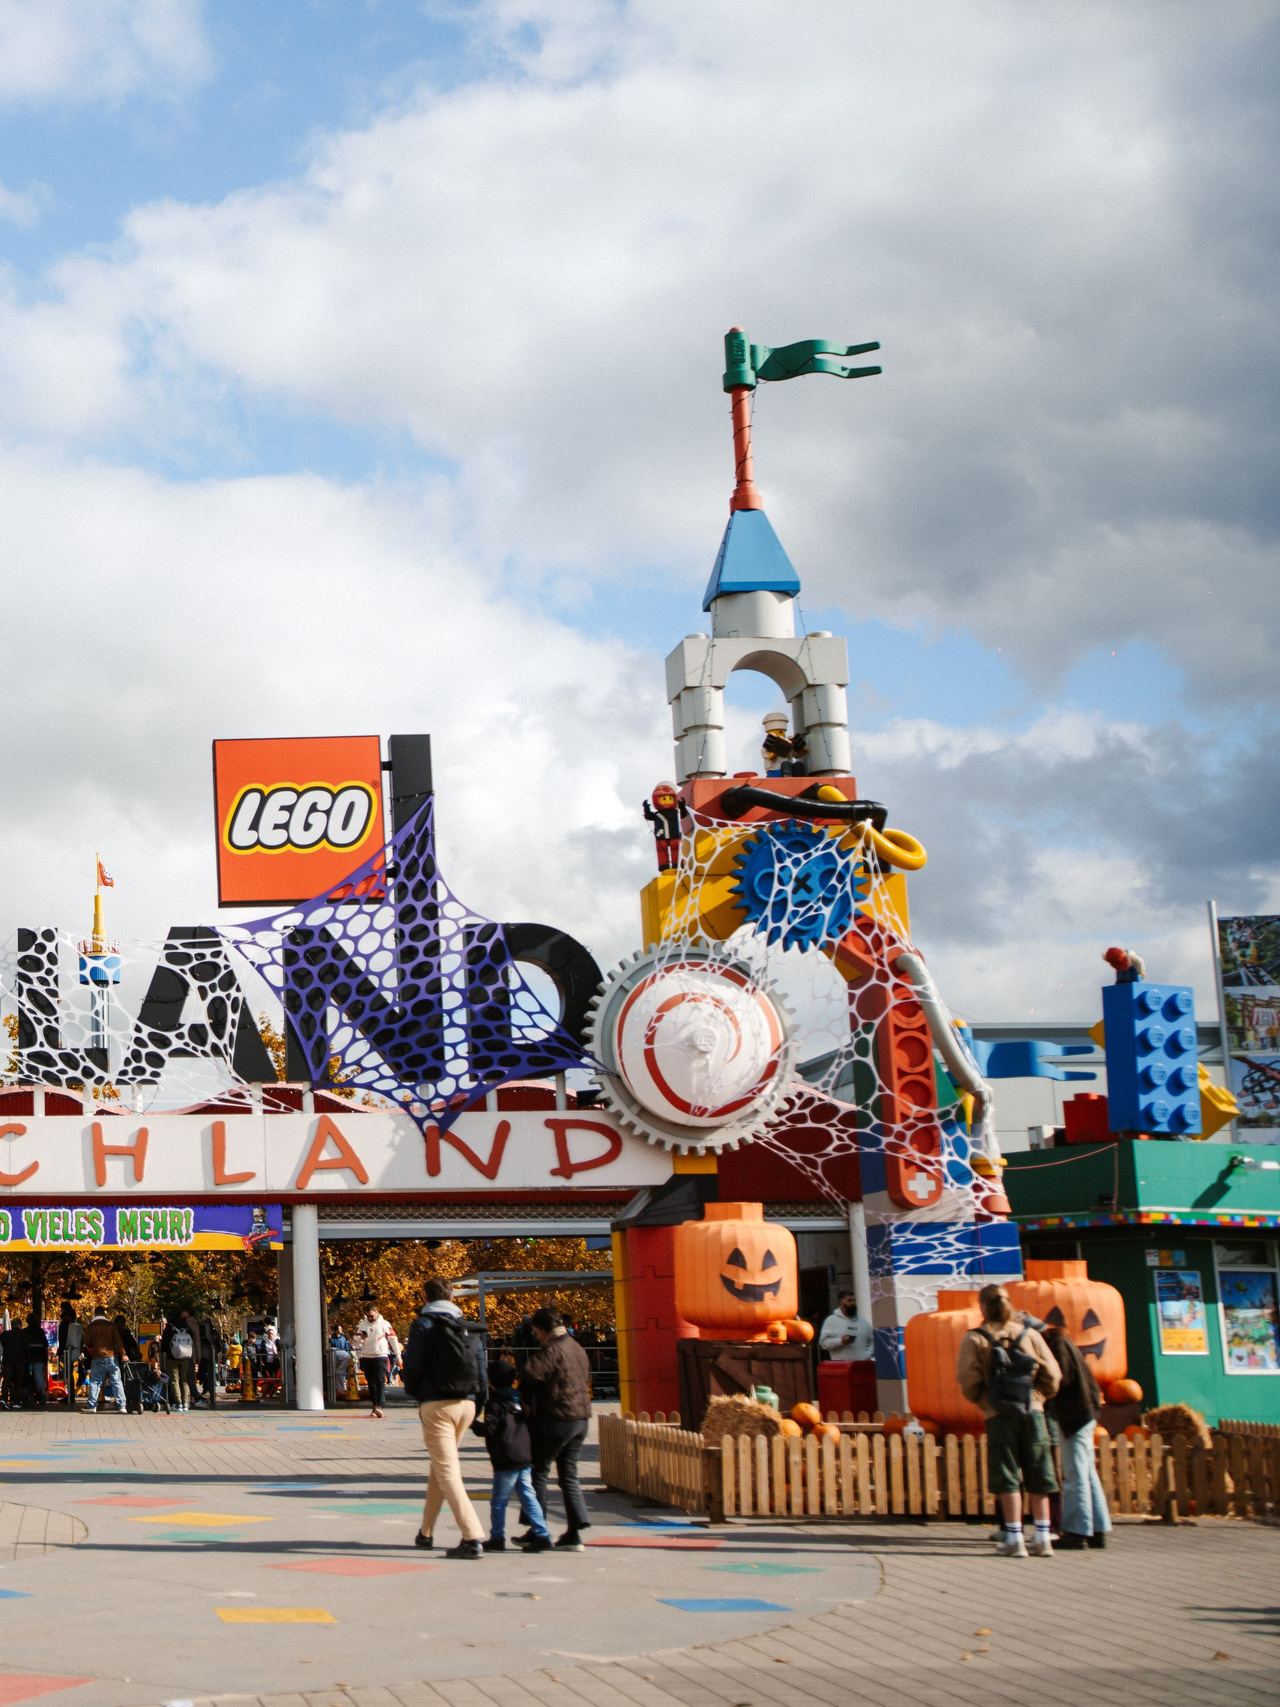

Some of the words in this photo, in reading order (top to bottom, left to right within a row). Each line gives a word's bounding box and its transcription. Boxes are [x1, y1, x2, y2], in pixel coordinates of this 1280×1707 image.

[228, 785, 373, 851] LEGO
[24, 1210, 103, 1246] VIELES
[119, 1210, 192, 1245] MEHR!
